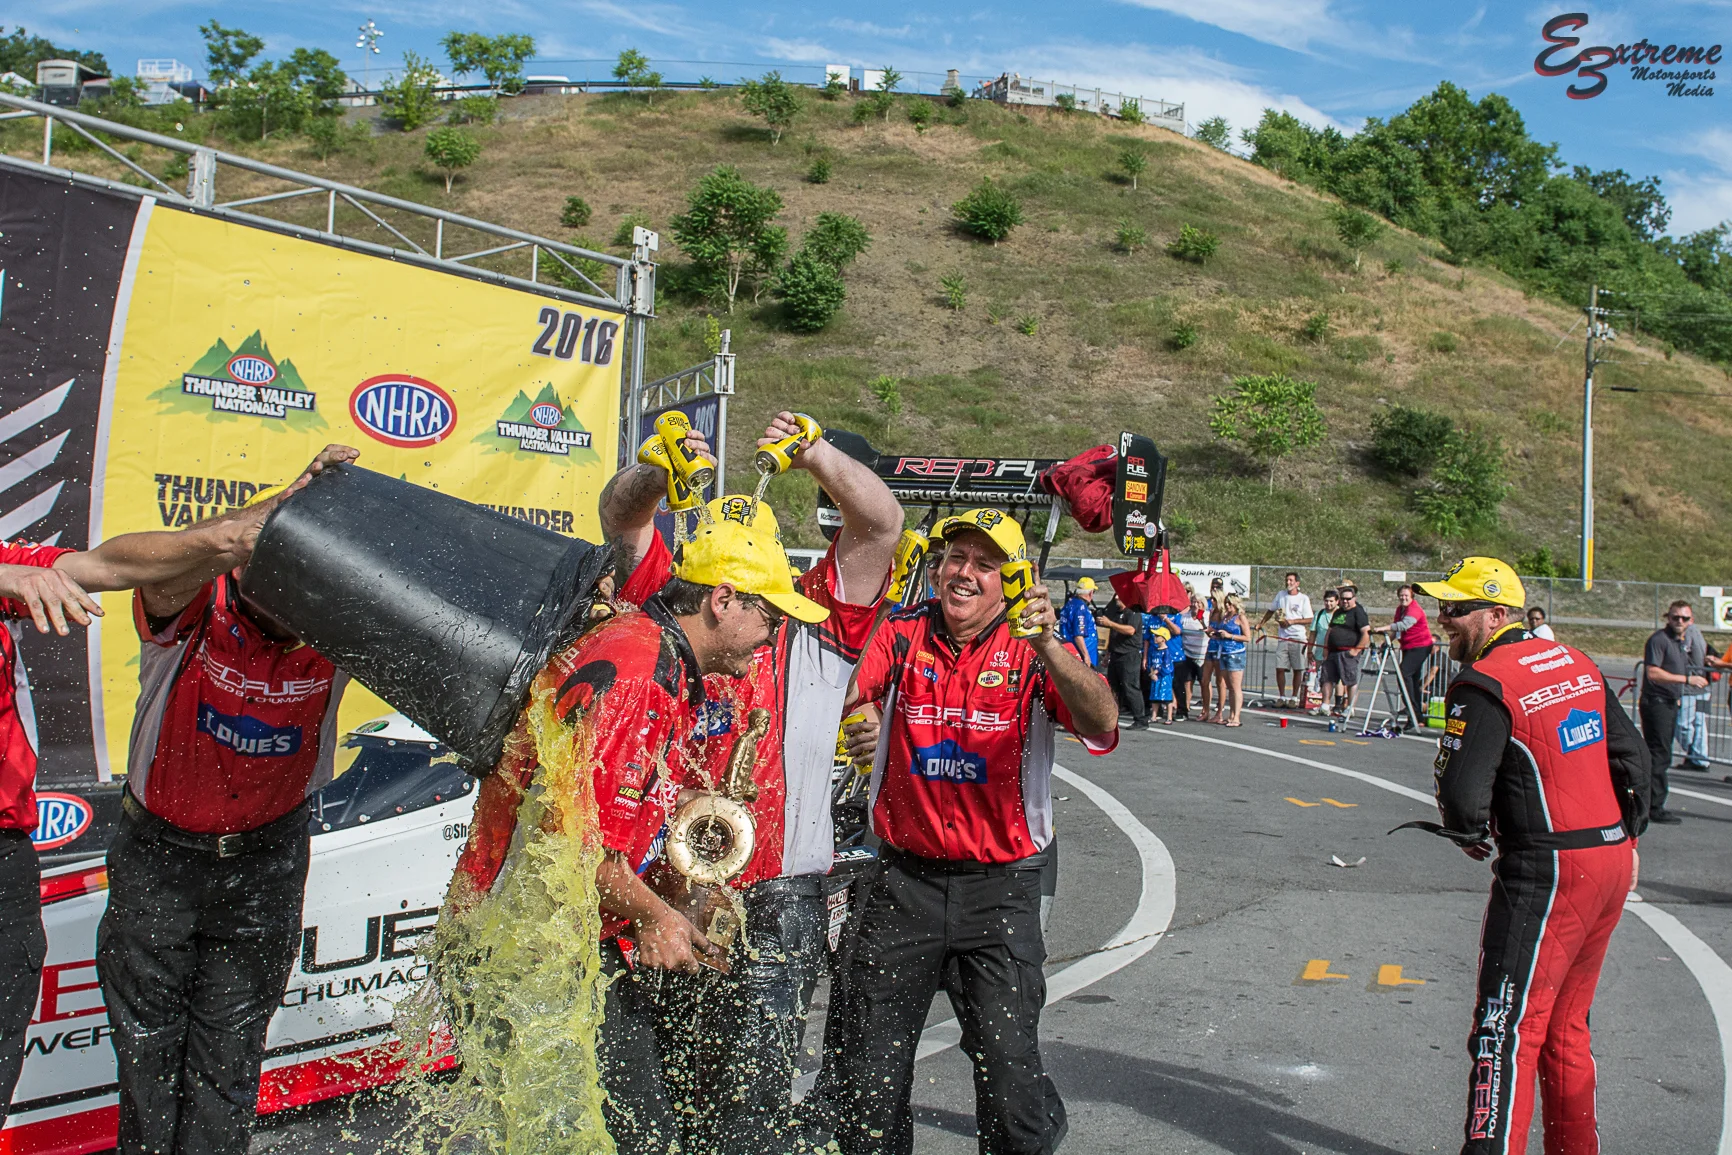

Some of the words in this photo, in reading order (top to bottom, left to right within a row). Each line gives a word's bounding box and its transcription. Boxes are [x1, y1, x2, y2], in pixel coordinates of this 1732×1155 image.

[532, 306, 619, 366] 2016
[234, 359, 270, 382] NHRA
[184, 377, 257, 401] THUNDER
[259, 387, 314, 408] VALLEY
[215, 397, 285, 417] NATIONALS
[366, 387, 443, 435] NHRA
[535, 406, 559, 424] NHRA
[498, 423, 550, 442] THUNDER
[551, 430, 591, 447] VALLEY
[520, 438, 568, 454] NATIONALS
[1127, 456, 1145, 466] RED
[1127, 464, 1149, 474] FUEL
[154, 473, 285, 507] THUND
[893, 489, 1058, 504] EDFUELPOWER.COM
[1126, 481, 1147, 493] SANDVIK
[1181, 568, 1205, 577] Spark
[1208, 569, 1231, 578] Plugs
[900, 694, 1010, 726] EDFUEL
[206, 711, 291, 754] LOWE'S
[917, 753, 977, 780] LOWE'S
[1488, 1073, 1500, 1139] POWERED
[1494, 1052, 1502, 1071] BY
